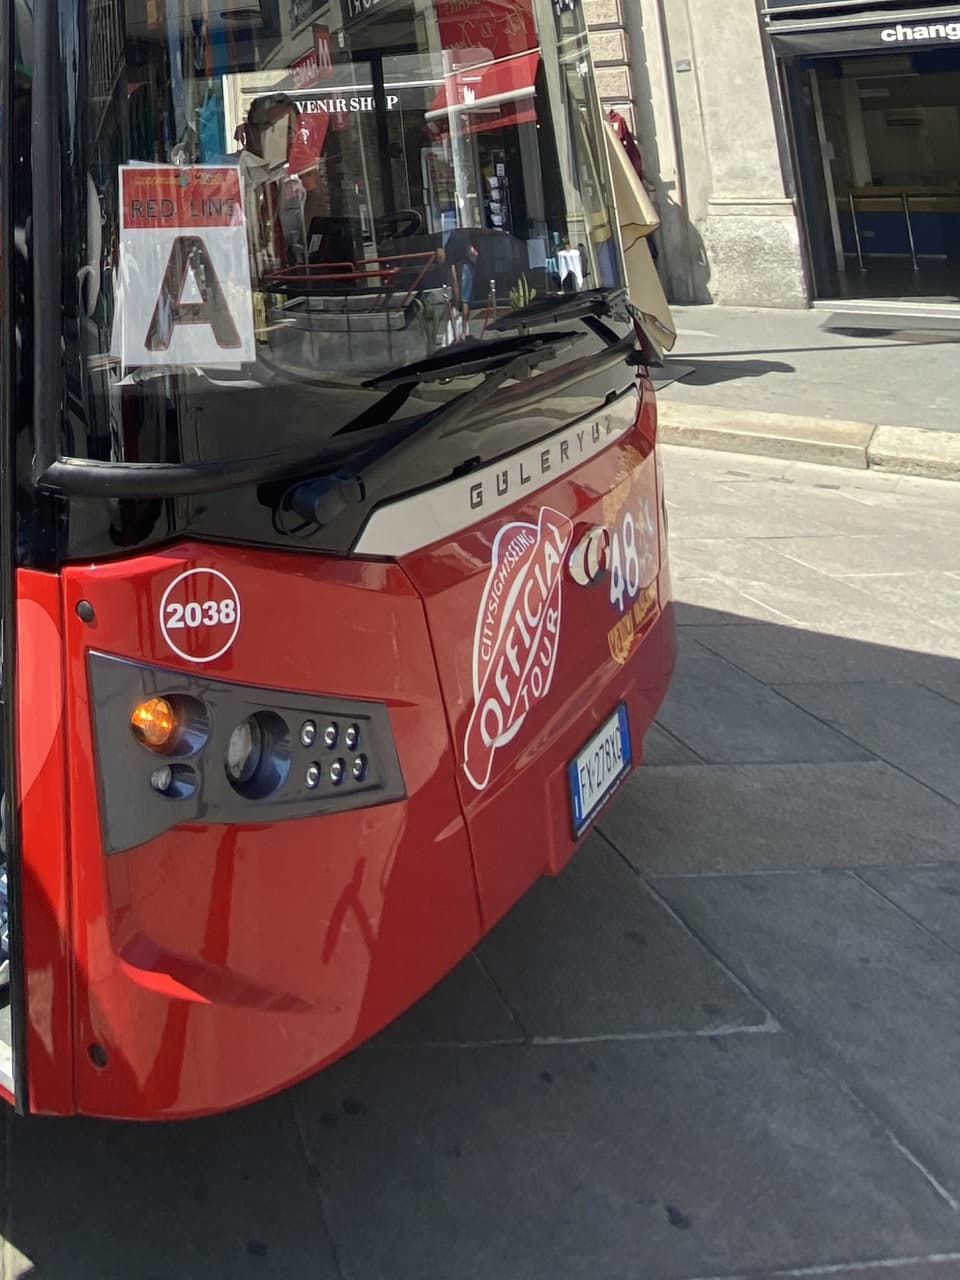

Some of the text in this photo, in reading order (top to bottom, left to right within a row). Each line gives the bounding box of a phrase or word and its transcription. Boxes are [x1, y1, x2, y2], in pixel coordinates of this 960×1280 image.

[349, 95, 398, 112] SHP
[131, 197, 238, 219] RED LINE
[143, 234, 242, 352] A
[166, 598, 236, 629] 2038
[480, 522, 569, 749] OFFICIAL
[481, 528, 535, 662] CITYSIGHTSEEING
[521, 608, 560, 713] TOUR
